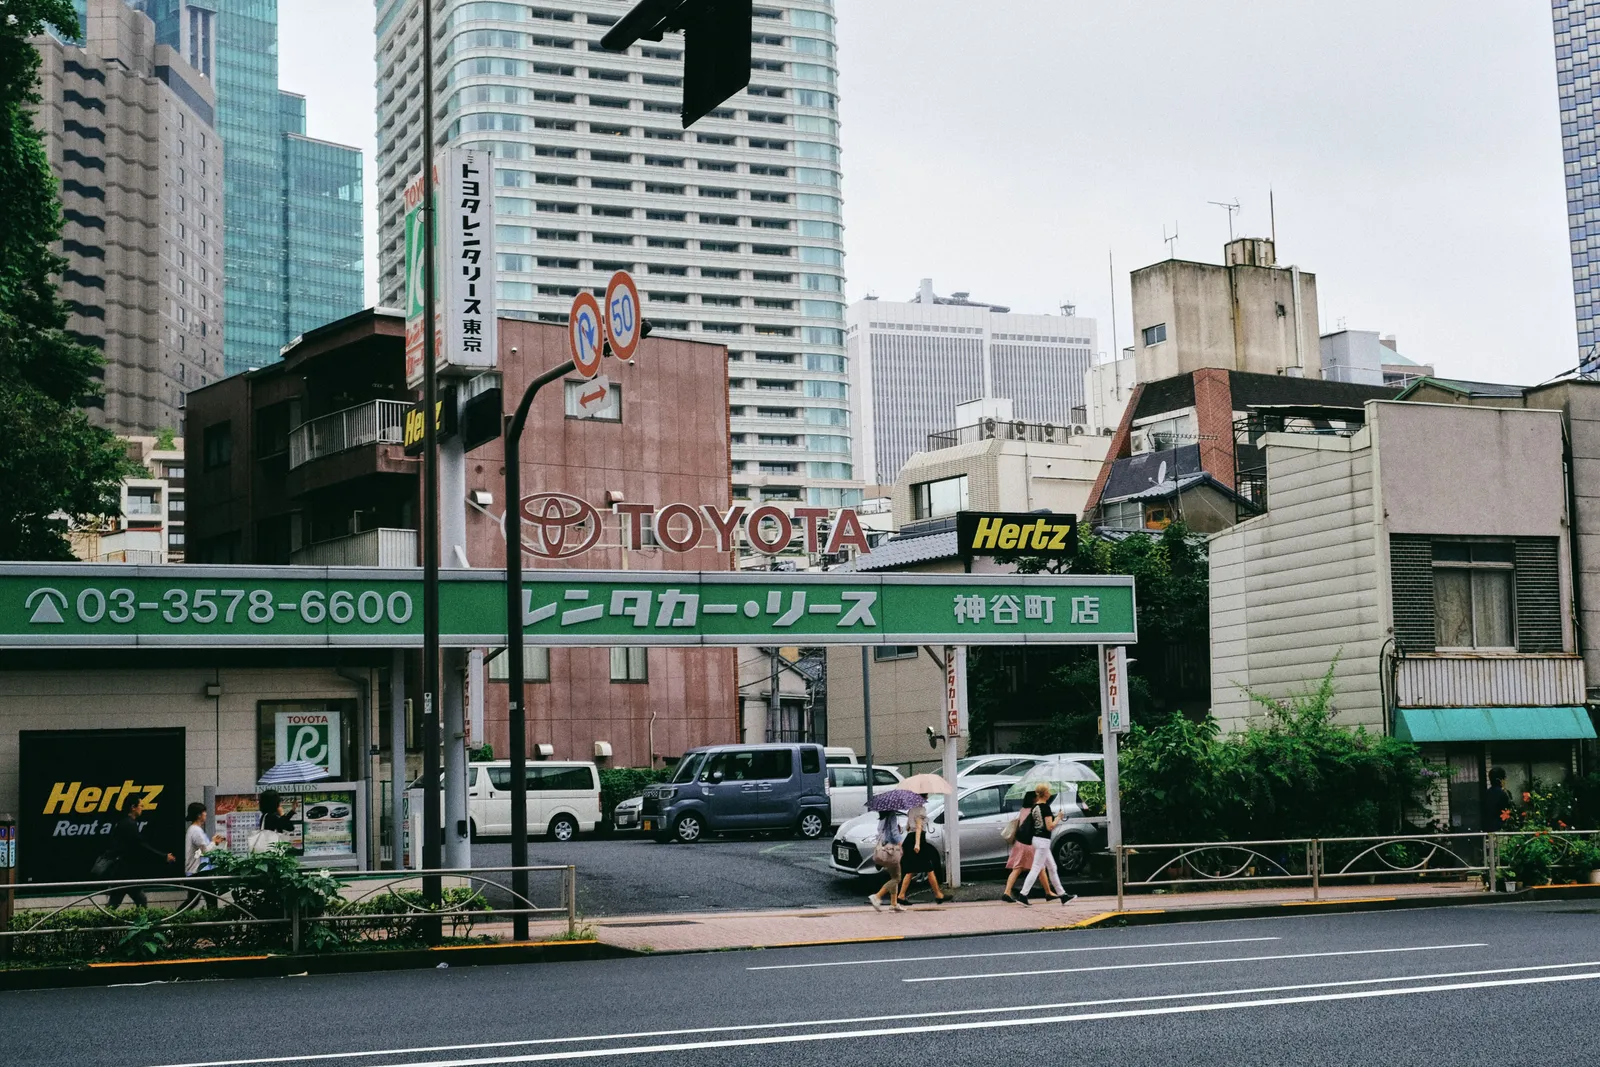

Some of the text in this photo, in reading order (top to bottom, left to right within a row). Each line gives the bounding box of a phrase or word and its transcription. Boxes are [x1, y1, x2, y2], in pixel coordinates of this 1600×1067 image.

[461, 164, 482, 352] トヨタレンタリース東京
[611, 294, 632, 337] 50
[613, 503, 871, 554] TOYOTA
[972, 517, 1070, 550] Hertz
[76, 588, 413, 624] 03-3578-6600
[1108, 652, 1117, 705] レンタカー
[287, 715, 328, 724] TOYOTA
[42, 780, 164, 814] Hertz
[52, 820, 98, 836] Rent
[100, 822, 112, 834] a
